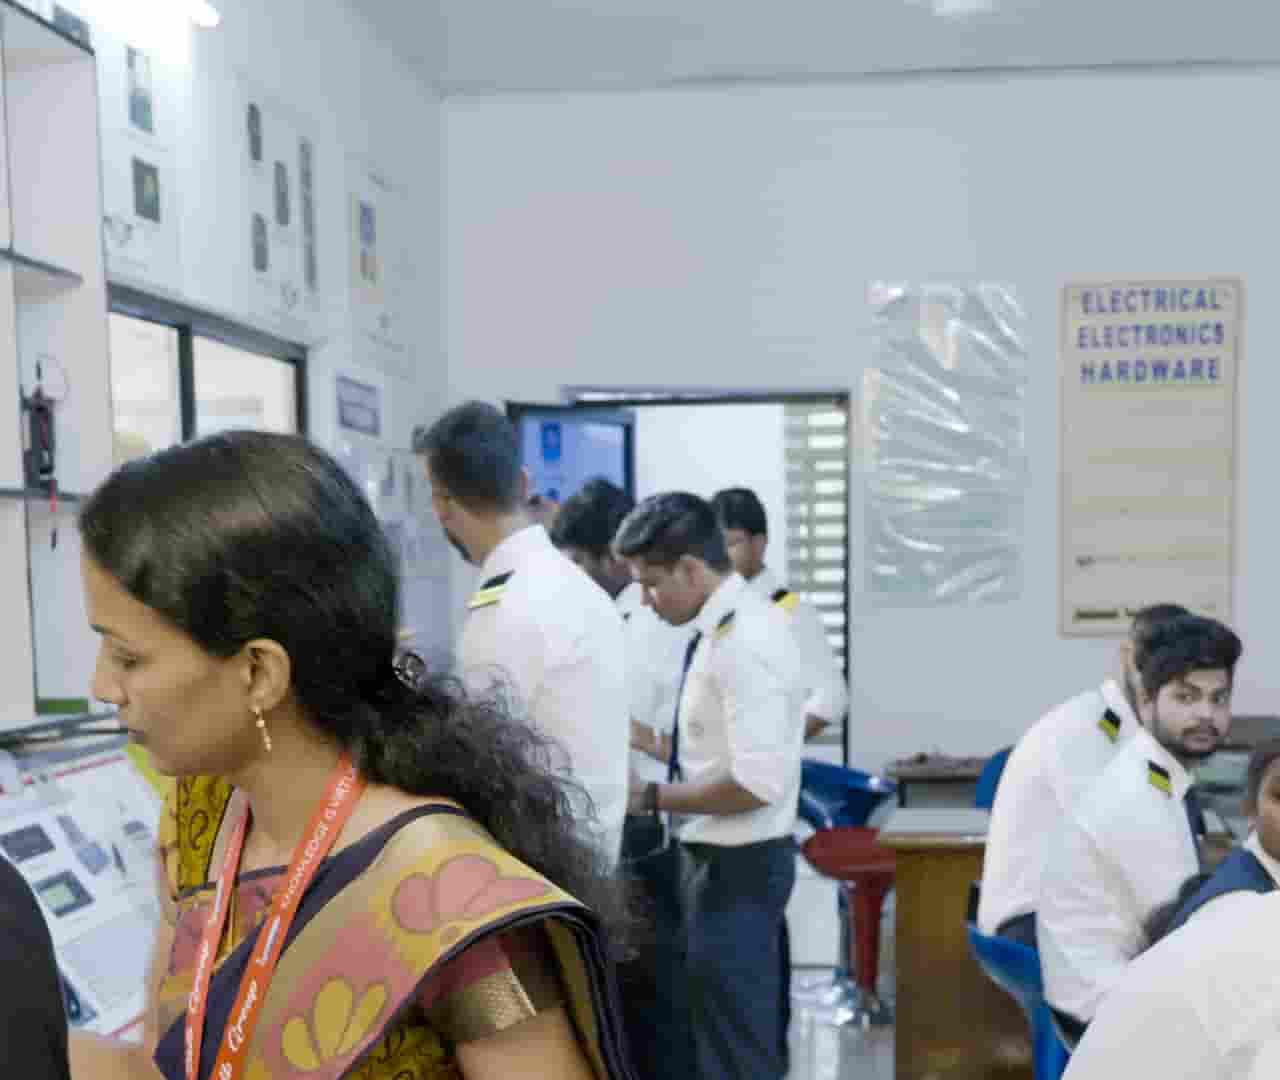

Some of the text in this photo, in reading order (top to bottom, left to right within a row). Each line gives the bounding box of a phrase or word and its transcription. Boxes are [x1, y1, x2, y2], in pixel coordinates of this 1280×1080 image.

[1080, 287, 1223, 315] ELECTRICAL
[1075, 321, 1226, 350] ELECTRONICS
[1079, 356, 1222, 385] HARDWARE
